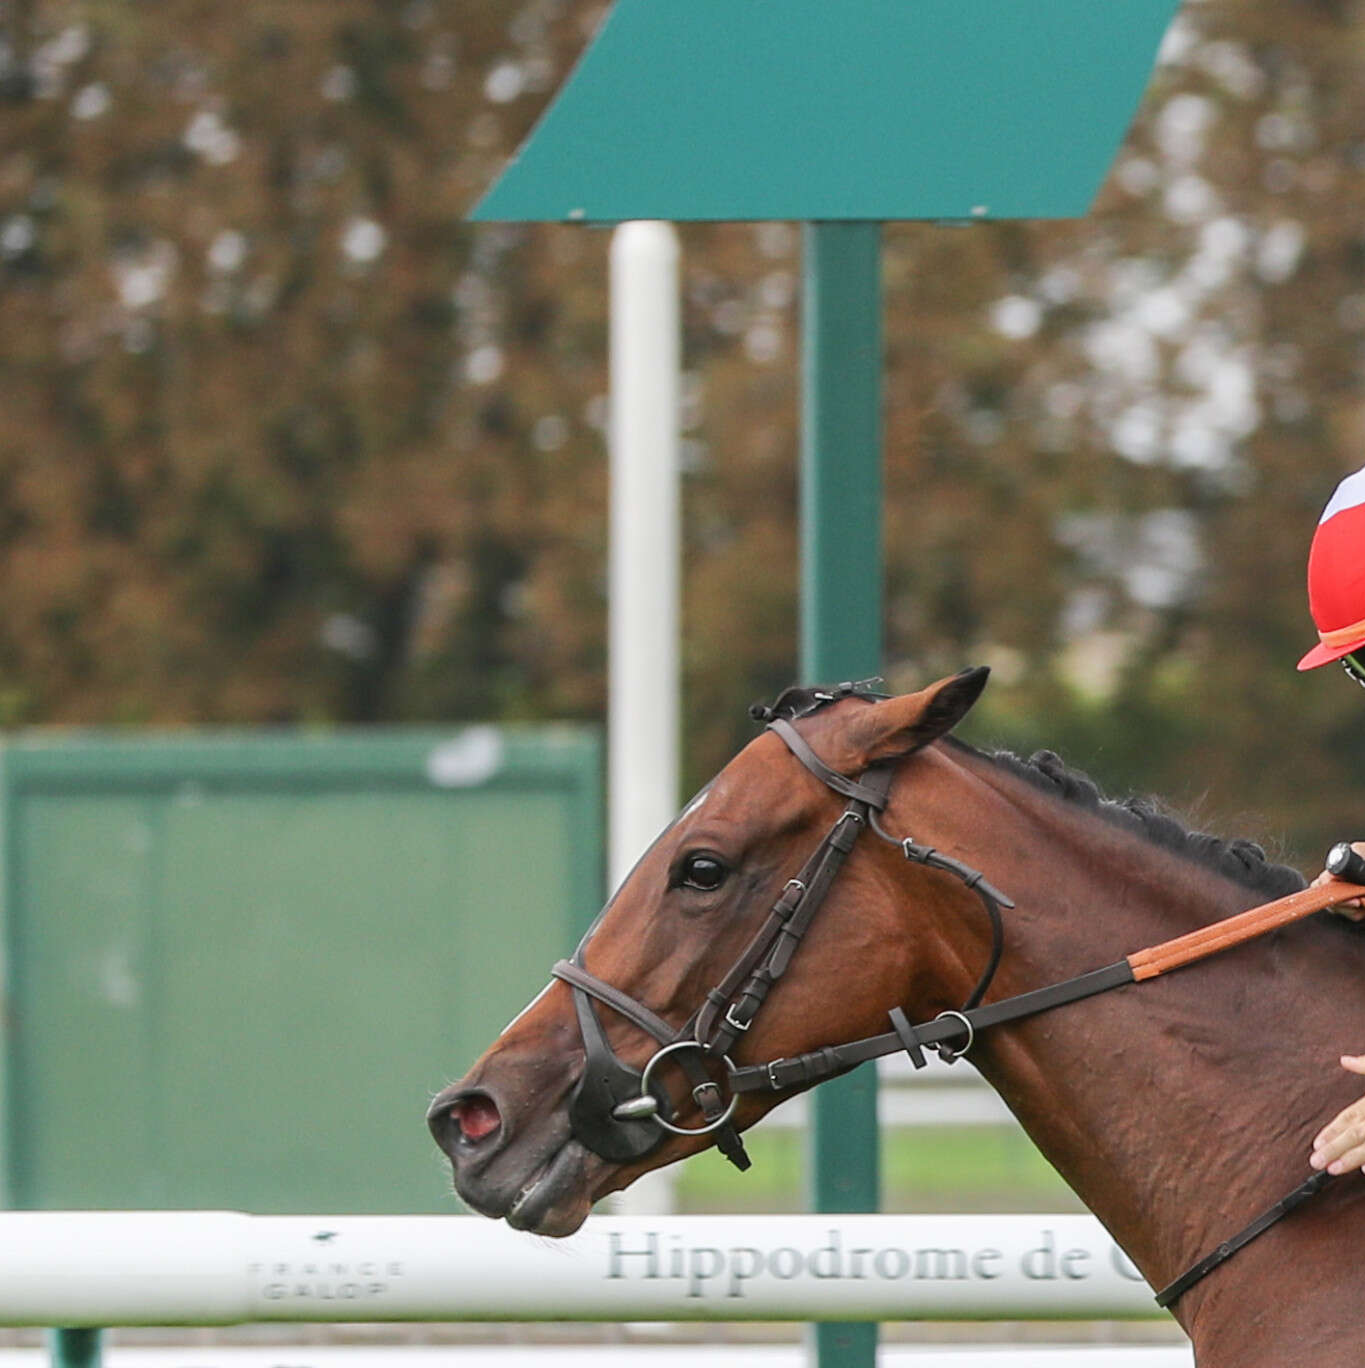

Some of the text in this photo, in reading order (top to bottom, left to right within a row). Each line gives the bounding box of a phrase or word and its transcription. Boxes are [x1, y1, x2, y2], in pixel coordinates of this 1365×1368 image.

[604, 1230, 1002, 1298] Hippodrome
[1021, 1230, 1090, 1280] de
[262, 1281, 389, 1300] GALOP
